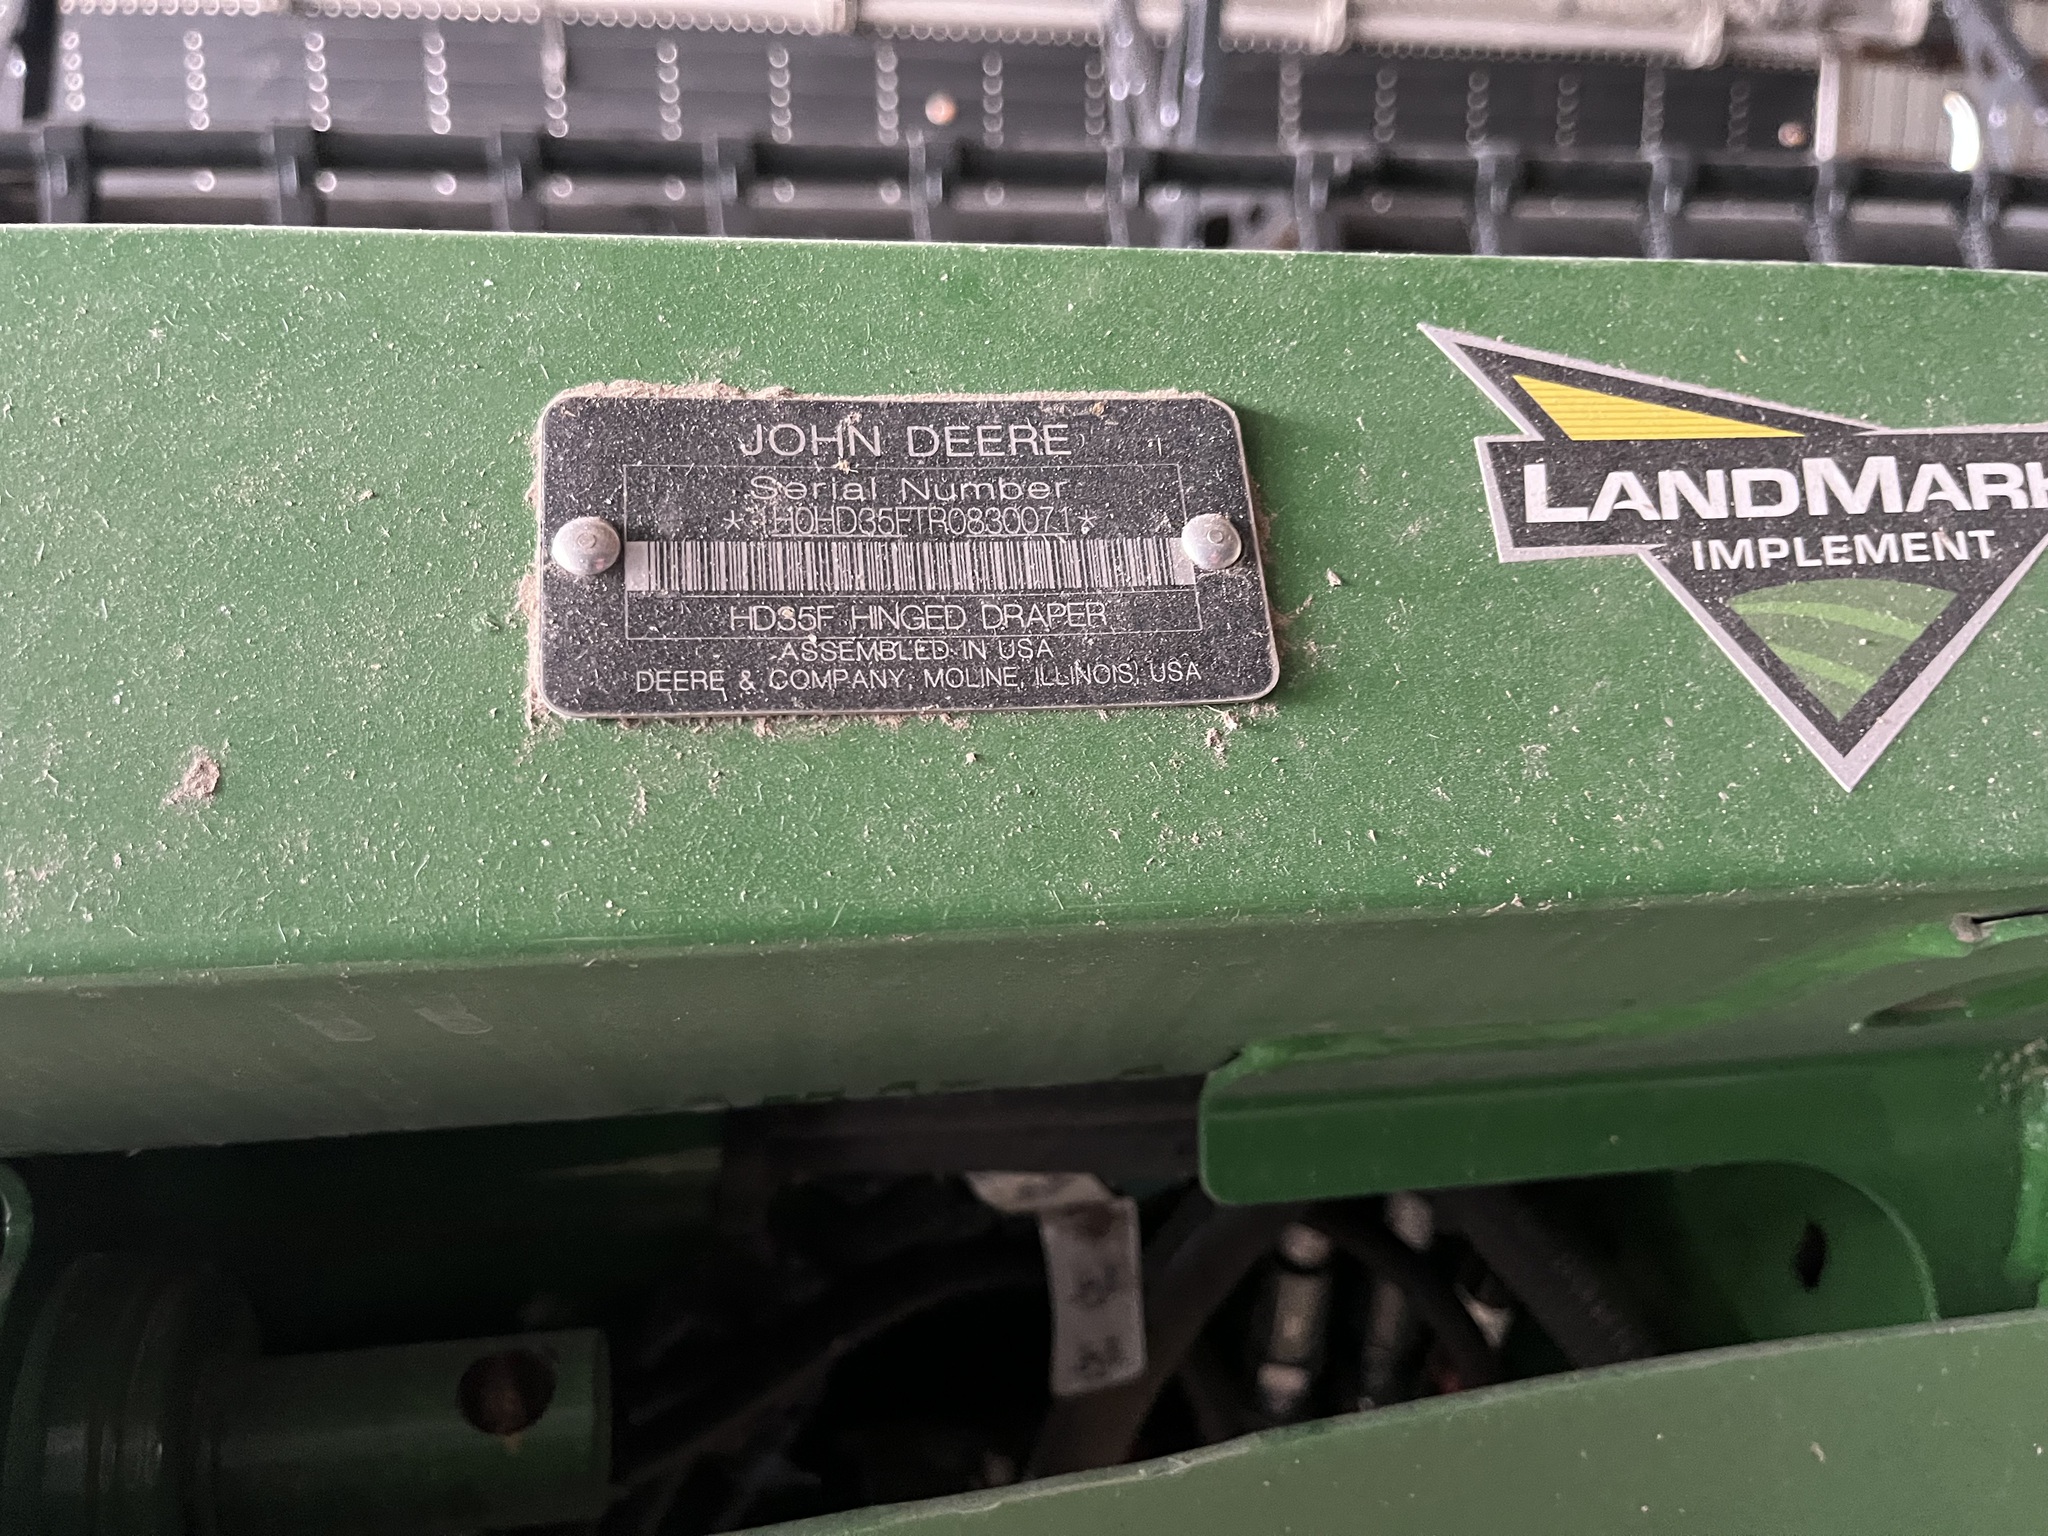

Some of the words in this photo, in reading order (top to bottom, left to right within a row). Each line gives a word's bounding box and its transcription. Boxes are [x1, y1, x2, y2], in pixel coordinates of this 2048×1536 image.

[742, 423, 882, 457] JOHN
[906, 424, 1073, 457] DEERE
[749, 475, 877, 501] Serial
[900, 476, 1070, 501] Number
[1692, 529, 1996, 571] IMPLEMENT
[851, 603, 966, 631] HINGED
[982, 602, 1108, 630] DRAPER
[780, 639, 949, 662] ASSEMBLED
[962, 639, 987, 661] IN
[998, 638, 1054, 661] USA
[636, 670, 725, 692] DEERE
[739, 669, 754, 690] &
[1149, 660, 1202, 682] USA
